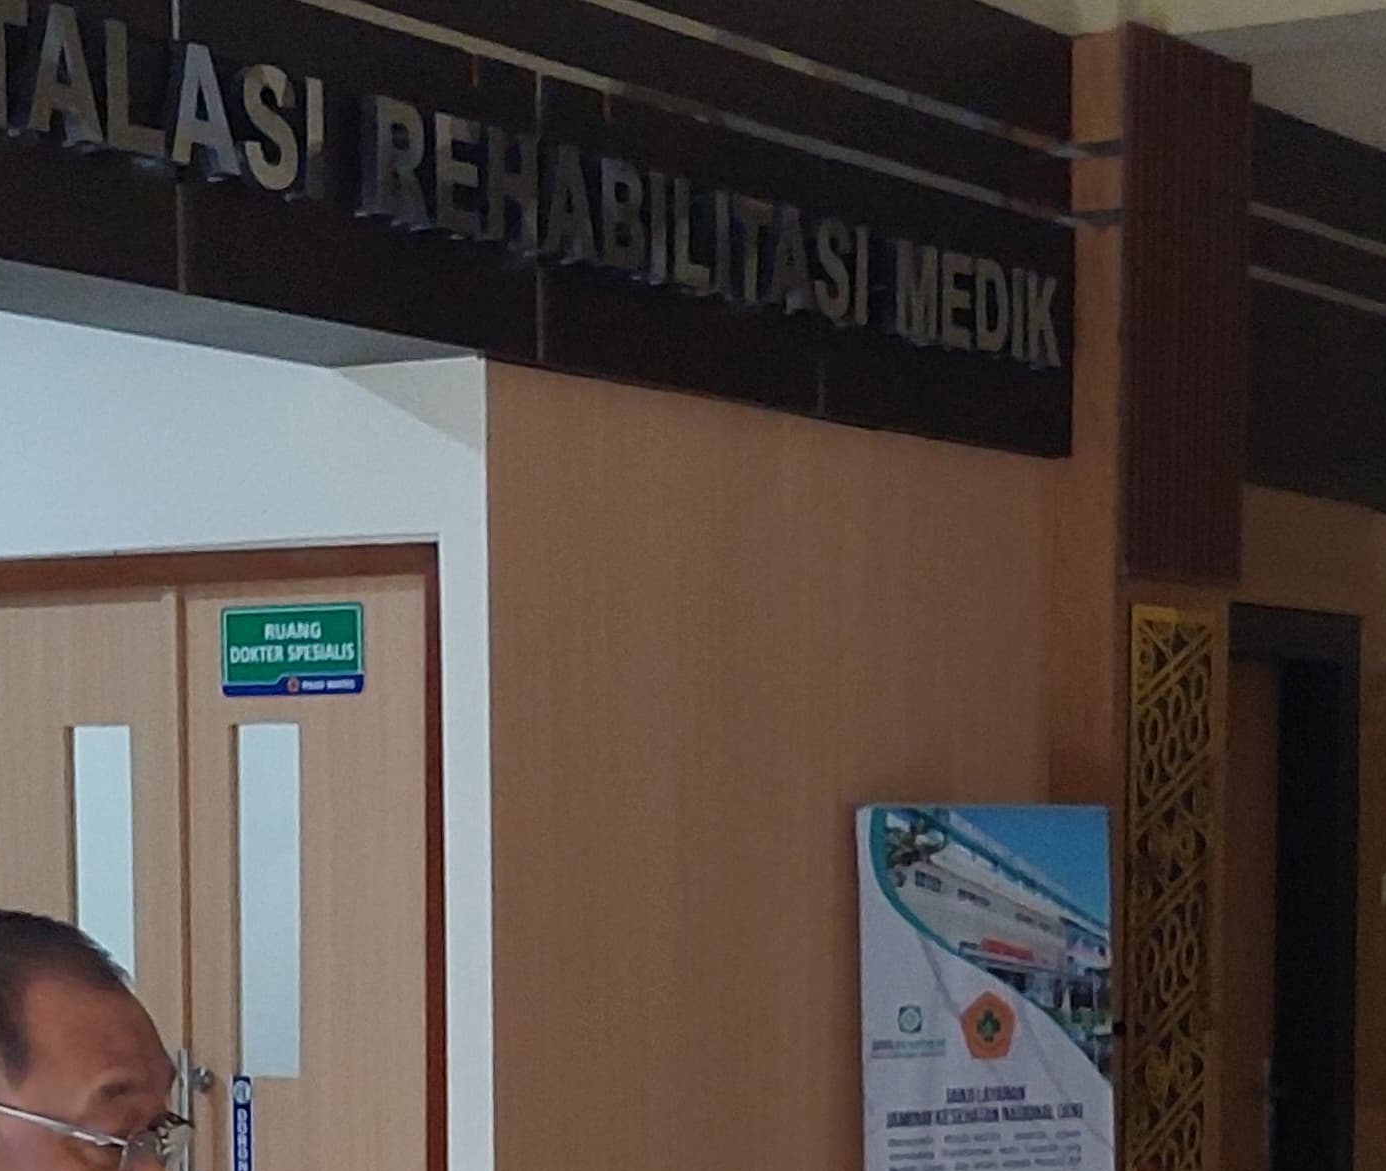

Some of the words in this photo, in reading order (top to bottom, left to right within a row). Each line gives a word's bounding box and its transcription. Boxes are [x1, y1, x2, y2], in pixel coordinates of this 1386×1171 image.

[365, 95, 869, 327] REHABILITASI
[894, 240, 1062, 369] MEDIK
[264, 621, 322, 641] RUANG
[229, 645, 284, 664] DOKTER
[287, 642, 355, 662] SPESIALIS
